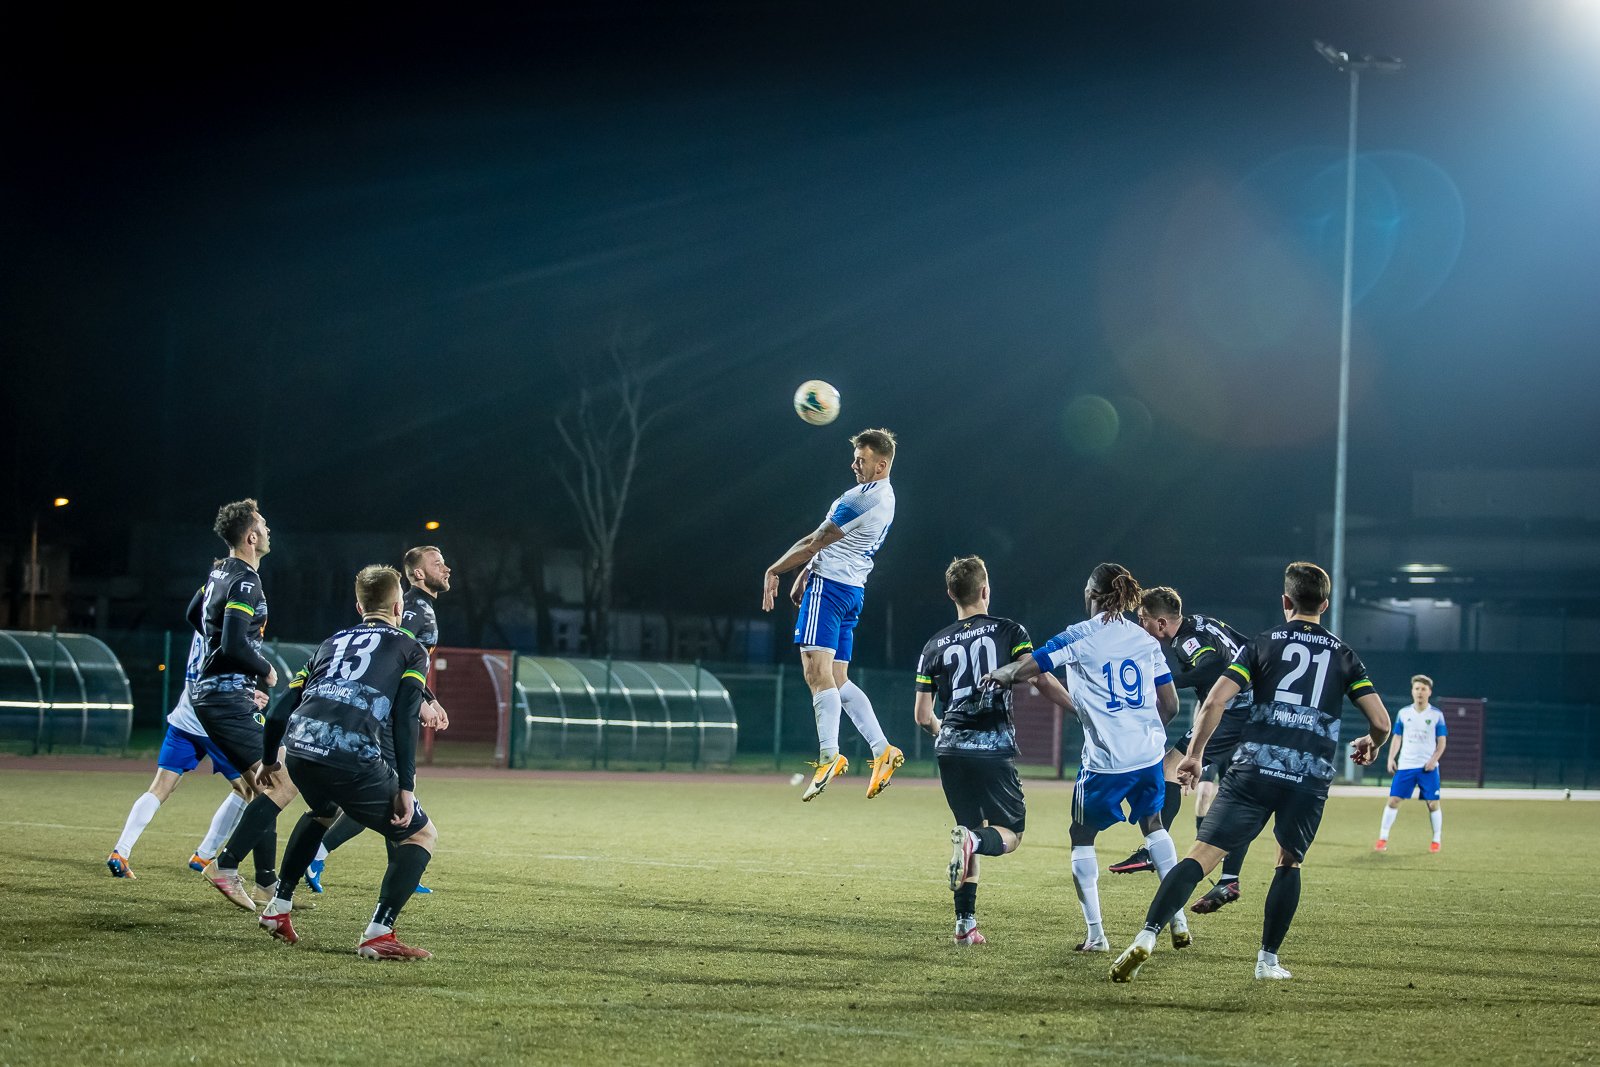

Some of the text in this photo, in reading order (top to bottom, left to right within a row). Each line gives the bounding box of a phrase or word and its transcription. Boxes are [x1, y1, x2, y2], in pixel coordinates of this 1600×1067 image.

[325, 632, 382, 681] 13
[943, 635, 998, 701] 20
[1274, 642, 1331, 709] 21
[1102, 658, 1146, 713] 19
[1273, 709, 1314, 726] PAWŁOWICE
